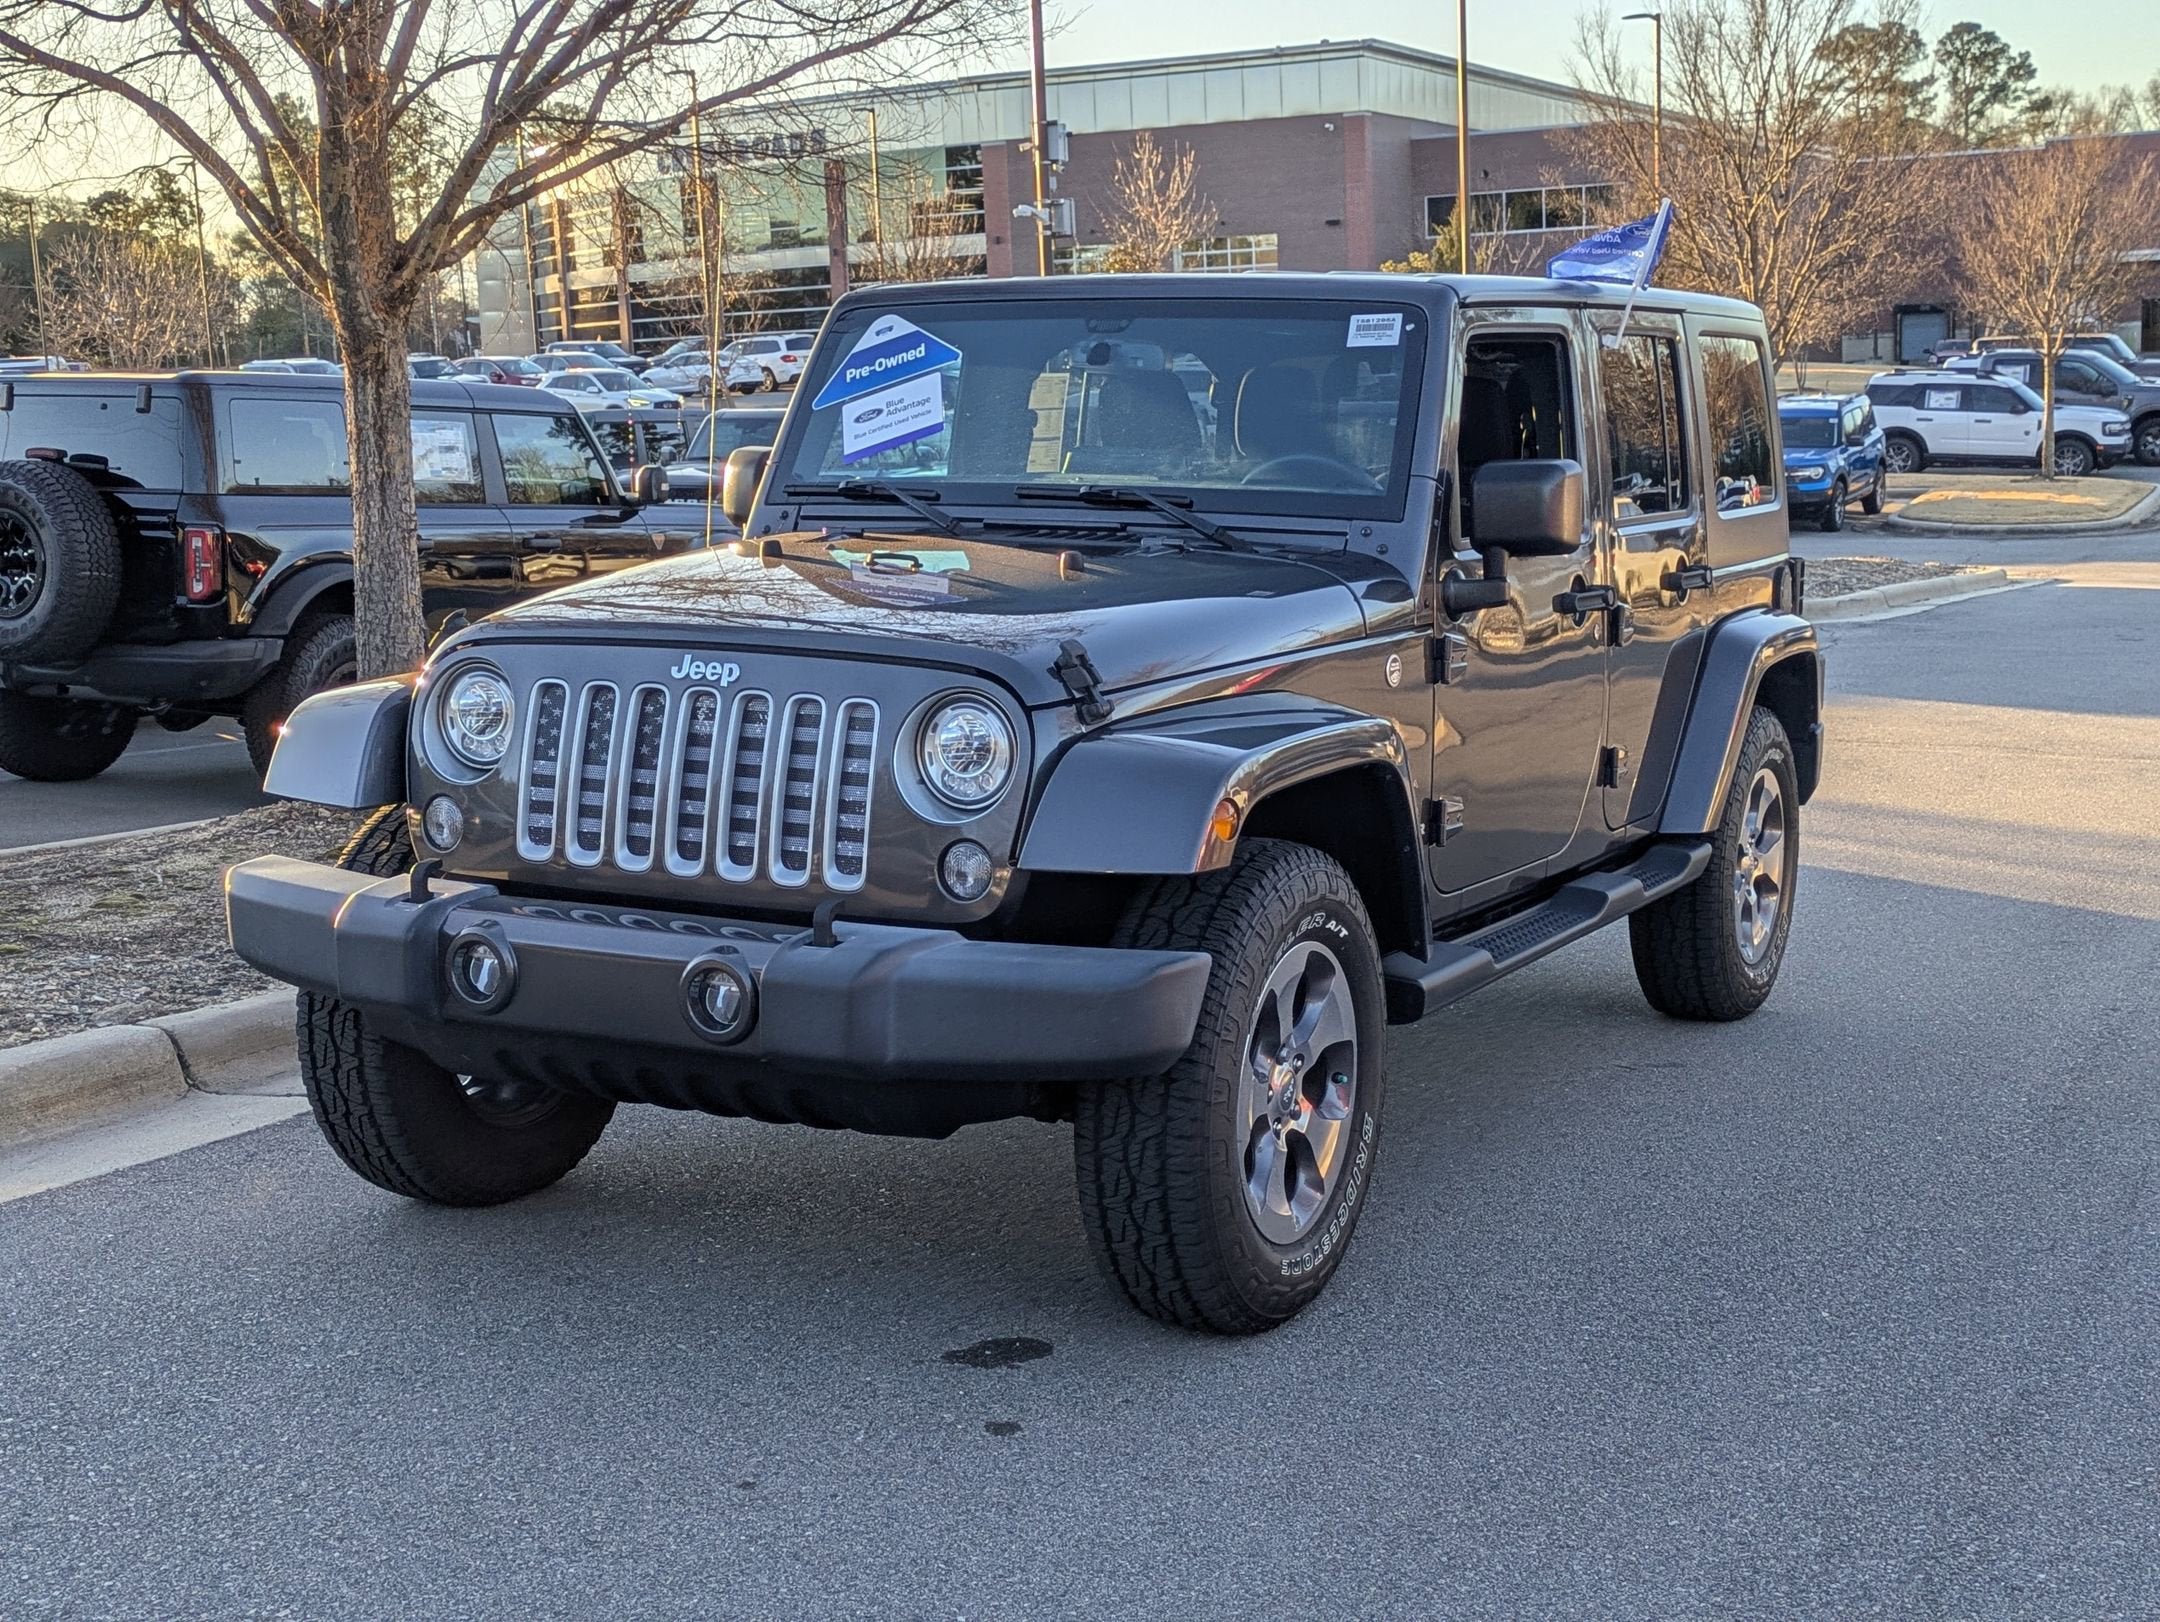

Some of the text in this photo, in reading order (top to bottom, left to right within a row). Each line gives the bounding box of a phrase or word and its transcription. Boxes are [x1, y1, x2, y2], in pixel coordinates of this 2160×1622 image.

[846, 343, 926, 383] Pre-Owned
[886, 397, 905, 409] Blue
[886, 397, 932, 417] Advantage
[868, 422, 893, 435] Certified
[894, 416, 910, 426] Used
[910, 409, 932, 420] Vehicle
[671, 654, 740, 687] Jeep
[1325, 920, 1349, 938] A/T
[1281, 1112, 1373, 1275] BRIDGESTONE
